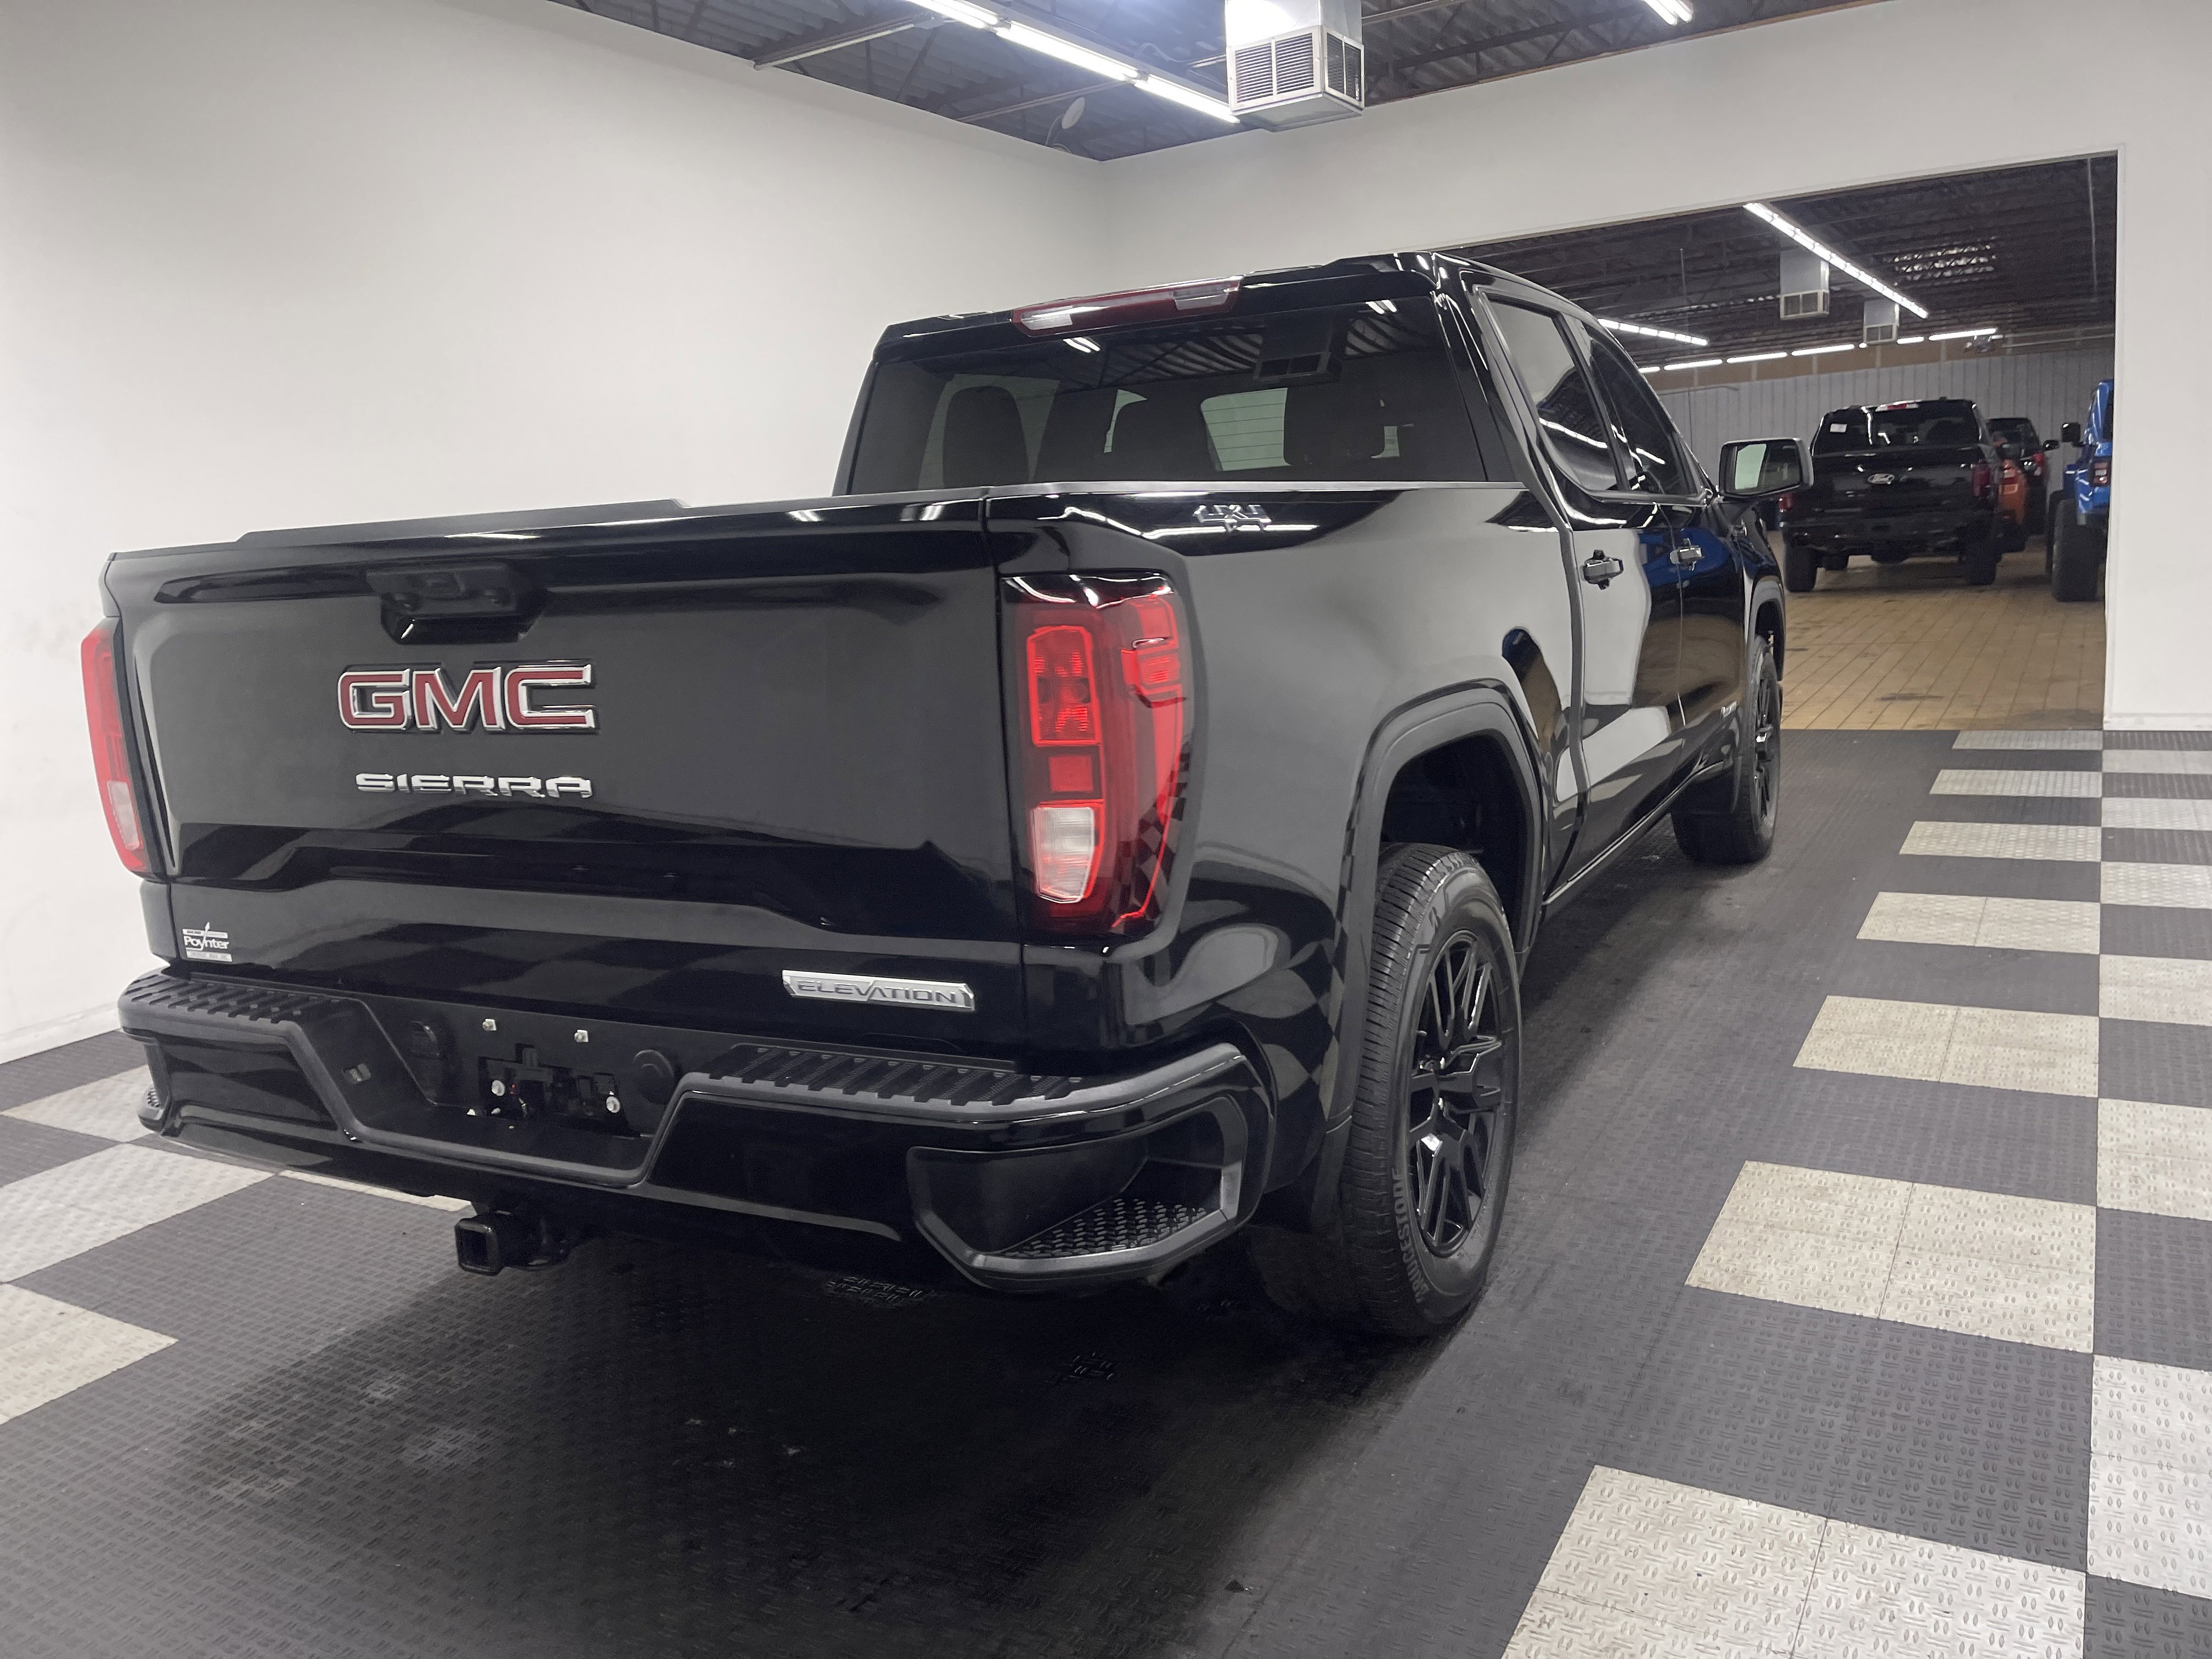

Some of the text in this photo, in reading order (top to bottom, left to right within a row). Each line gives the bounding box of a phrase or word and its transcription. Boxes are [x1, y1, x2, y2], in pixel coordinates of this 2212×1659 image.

[337, 664, 596, 731] GMC
[356, 773, 594, 798] SIERRA
[183, 935, 229, 950] Poynter
[798, 979, 957, 1003] ELEVATION
